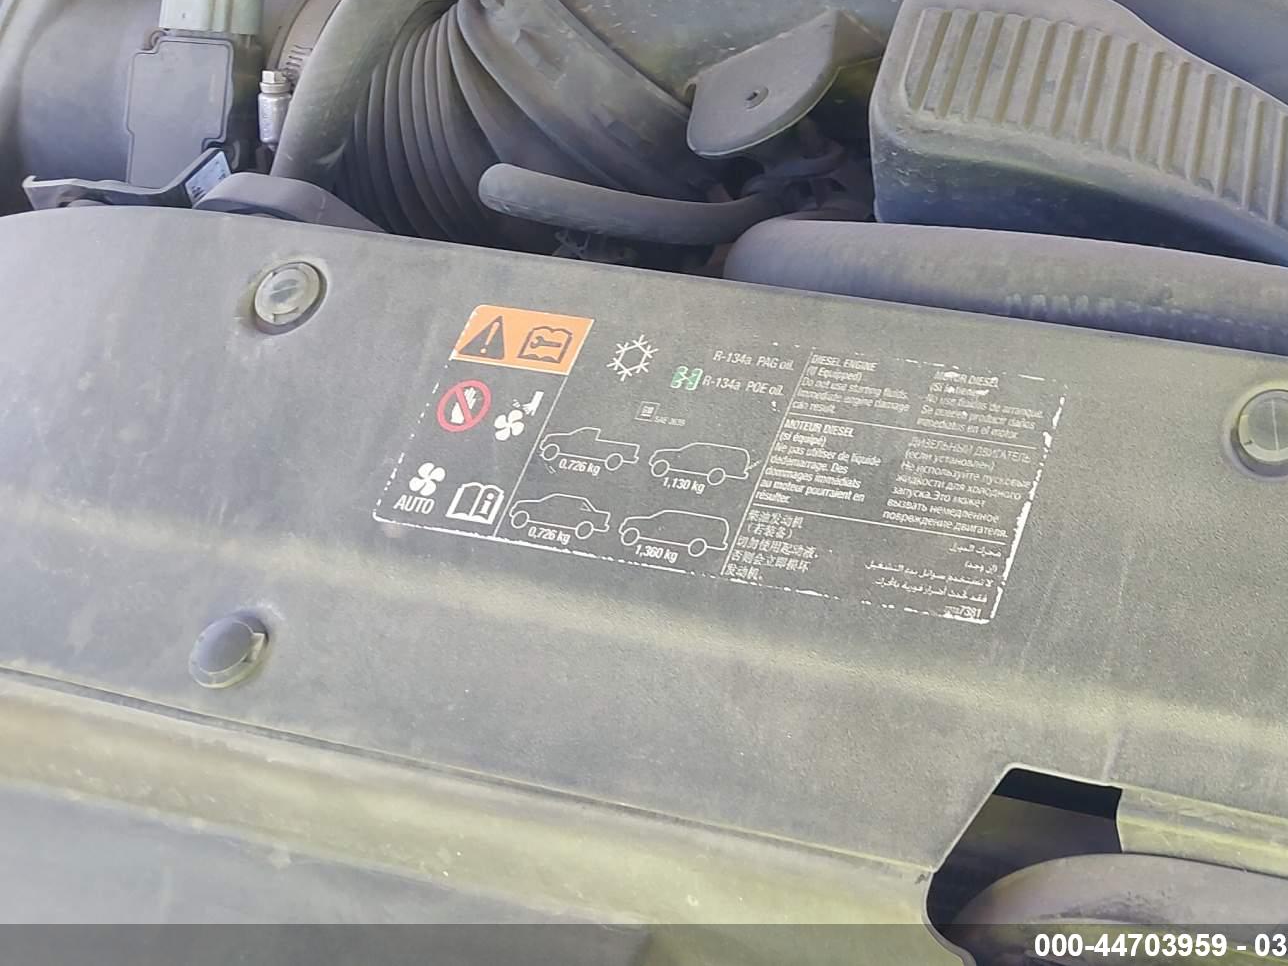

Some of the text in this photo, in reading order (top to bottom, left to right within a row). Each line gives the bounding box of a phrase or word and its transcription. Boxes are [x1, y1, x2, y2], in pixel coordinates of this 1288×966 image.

[713, 350, 752, 364] R-134a
[757, 356, 777, 367] PAG
[812, 355, 877, 370] DIESEL ENGINE
[702, 375, 741, 389] R-134a
[746, 381, 767, 392] POE
[874, 400, 909, 412] damage
[922, 405, 932, 413] Se
[785, 420, 856, 436] MOTEUR DIESEL
[789, 447, 803, 455] pas
[838, 452, 849, 460] de
[975, 446, 1031, 462] ДВИГАТЕЛЬ
[586, 464, 599, 475] kg
[764, 467, 813, 482] dommages
[831, 463, 847, 472] Des
[661, 477, 704, 493] 1,130 kg
[773, 481, 804, 491] moteur
[805, 485, 851, 500] pourraient
[947, 483, 963, 491] для
[393, 494, 435, 514] AUTO
[887, 499, 999, 523] вызвать немедленное
[556, 532, 569, 544] kg
[633, 545, 677, 562] 1,360 kg
